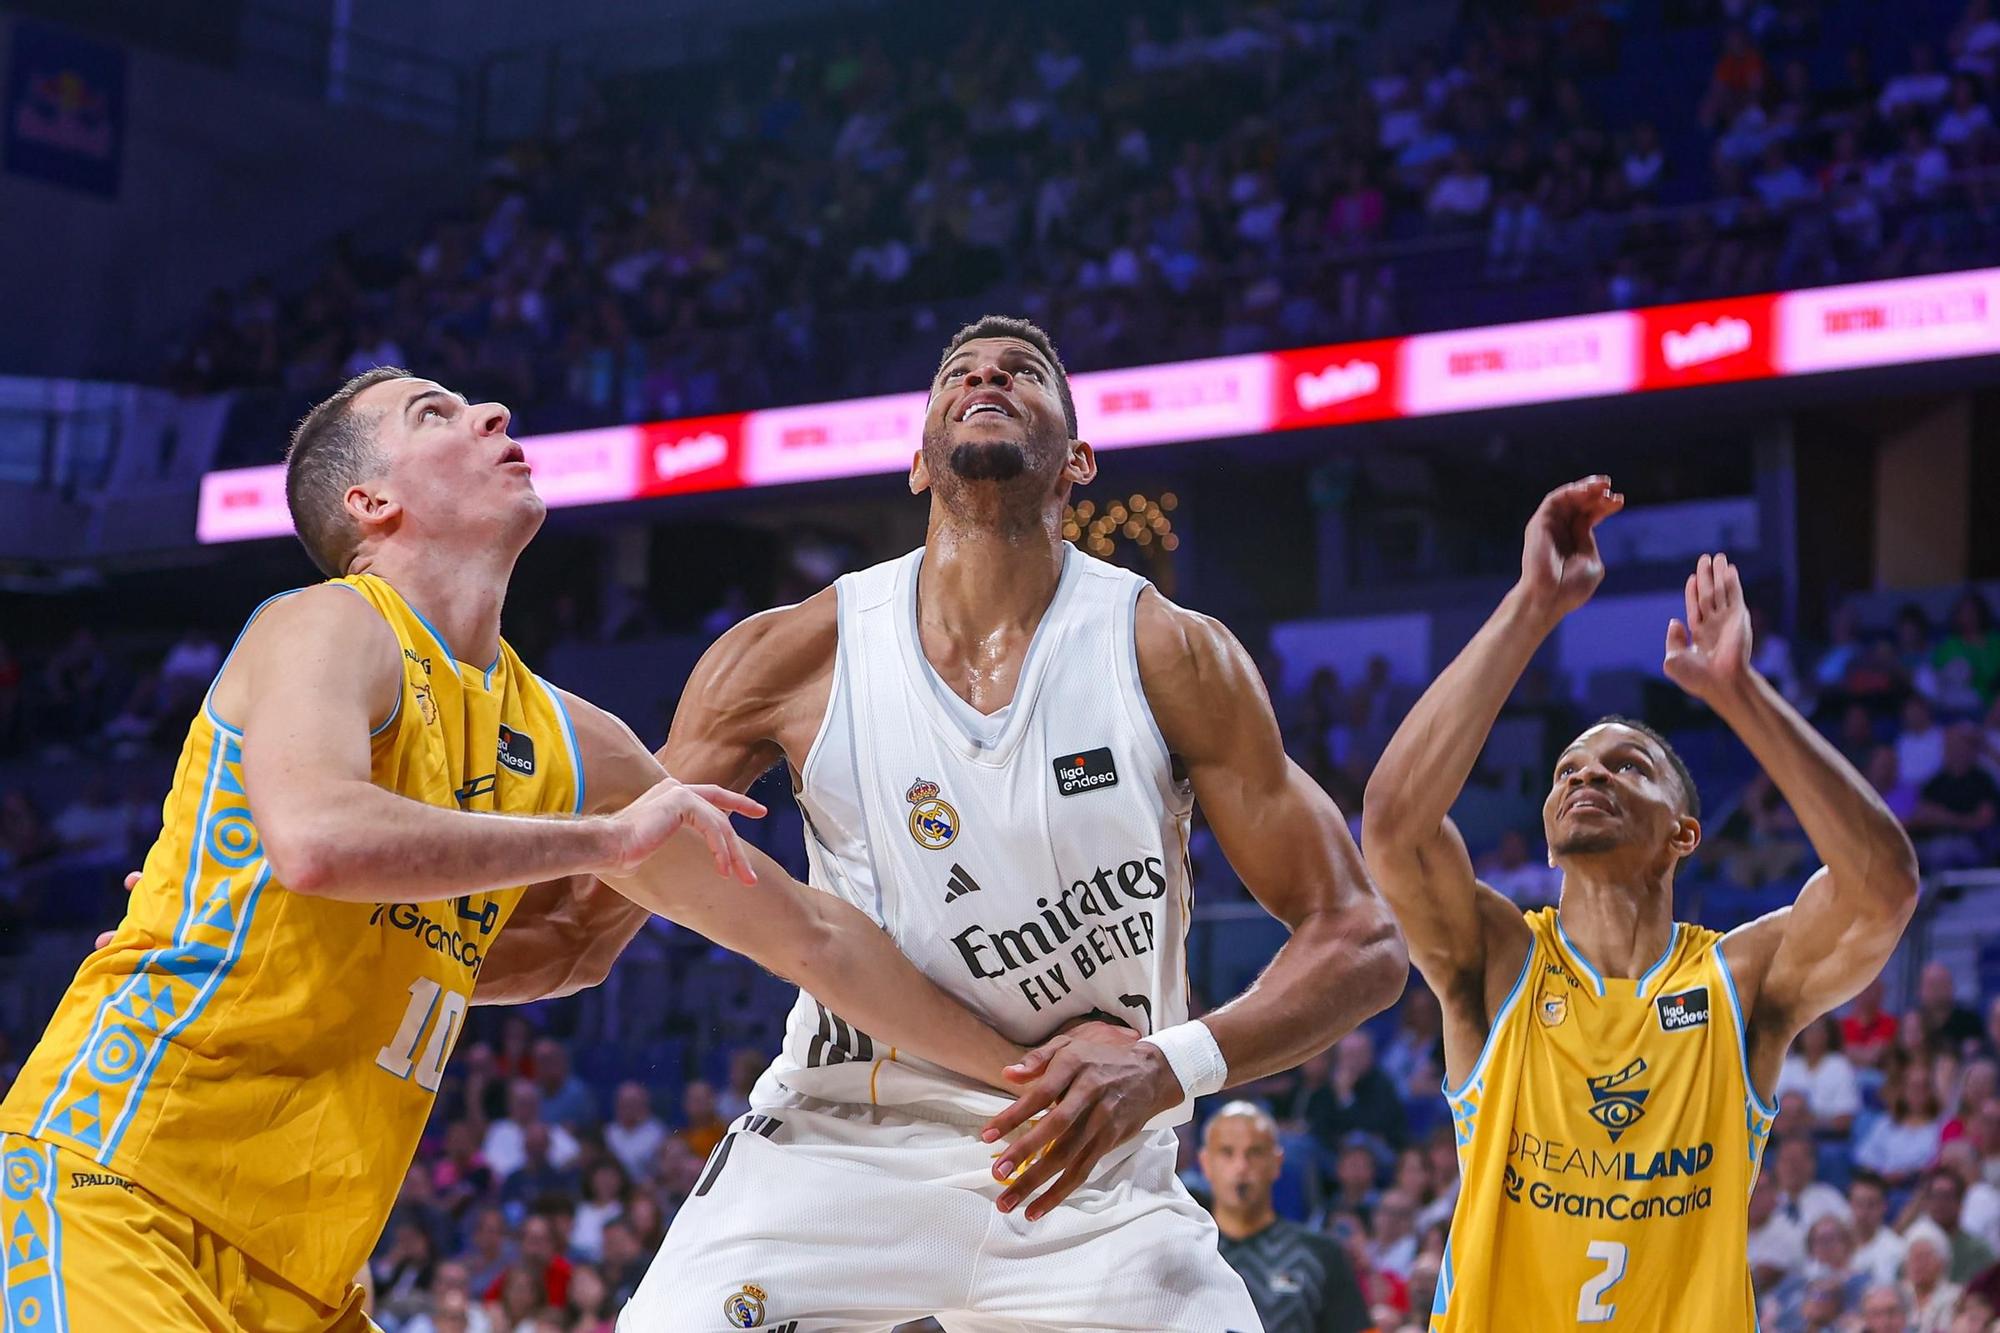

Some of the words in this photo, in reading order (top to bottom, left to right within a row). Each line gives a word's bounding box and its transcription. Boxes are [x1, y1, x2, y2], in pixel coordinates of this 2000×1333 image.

[498, 750, 532, 770] ndesa
[1059, 766, 1085, 780] liga
[1063, 771, 1115, 791] endesa
[950, 856, 1167, 979] Emirates
[1018, 963, 1073, 1012] FLY
[1071, 911, 1154, 980] BETER
[1662, 1004, 1685, 1018] liga
[1665, 1008, 1709, 1027] endesa
[375, 976, 466, 1093] 10
[1507, 1127, 1714, 1182] DREAMLAND
[1528, 1182, 1713, 1221] GranCanaria
[1576, 1240, 1630, 1324] 2
